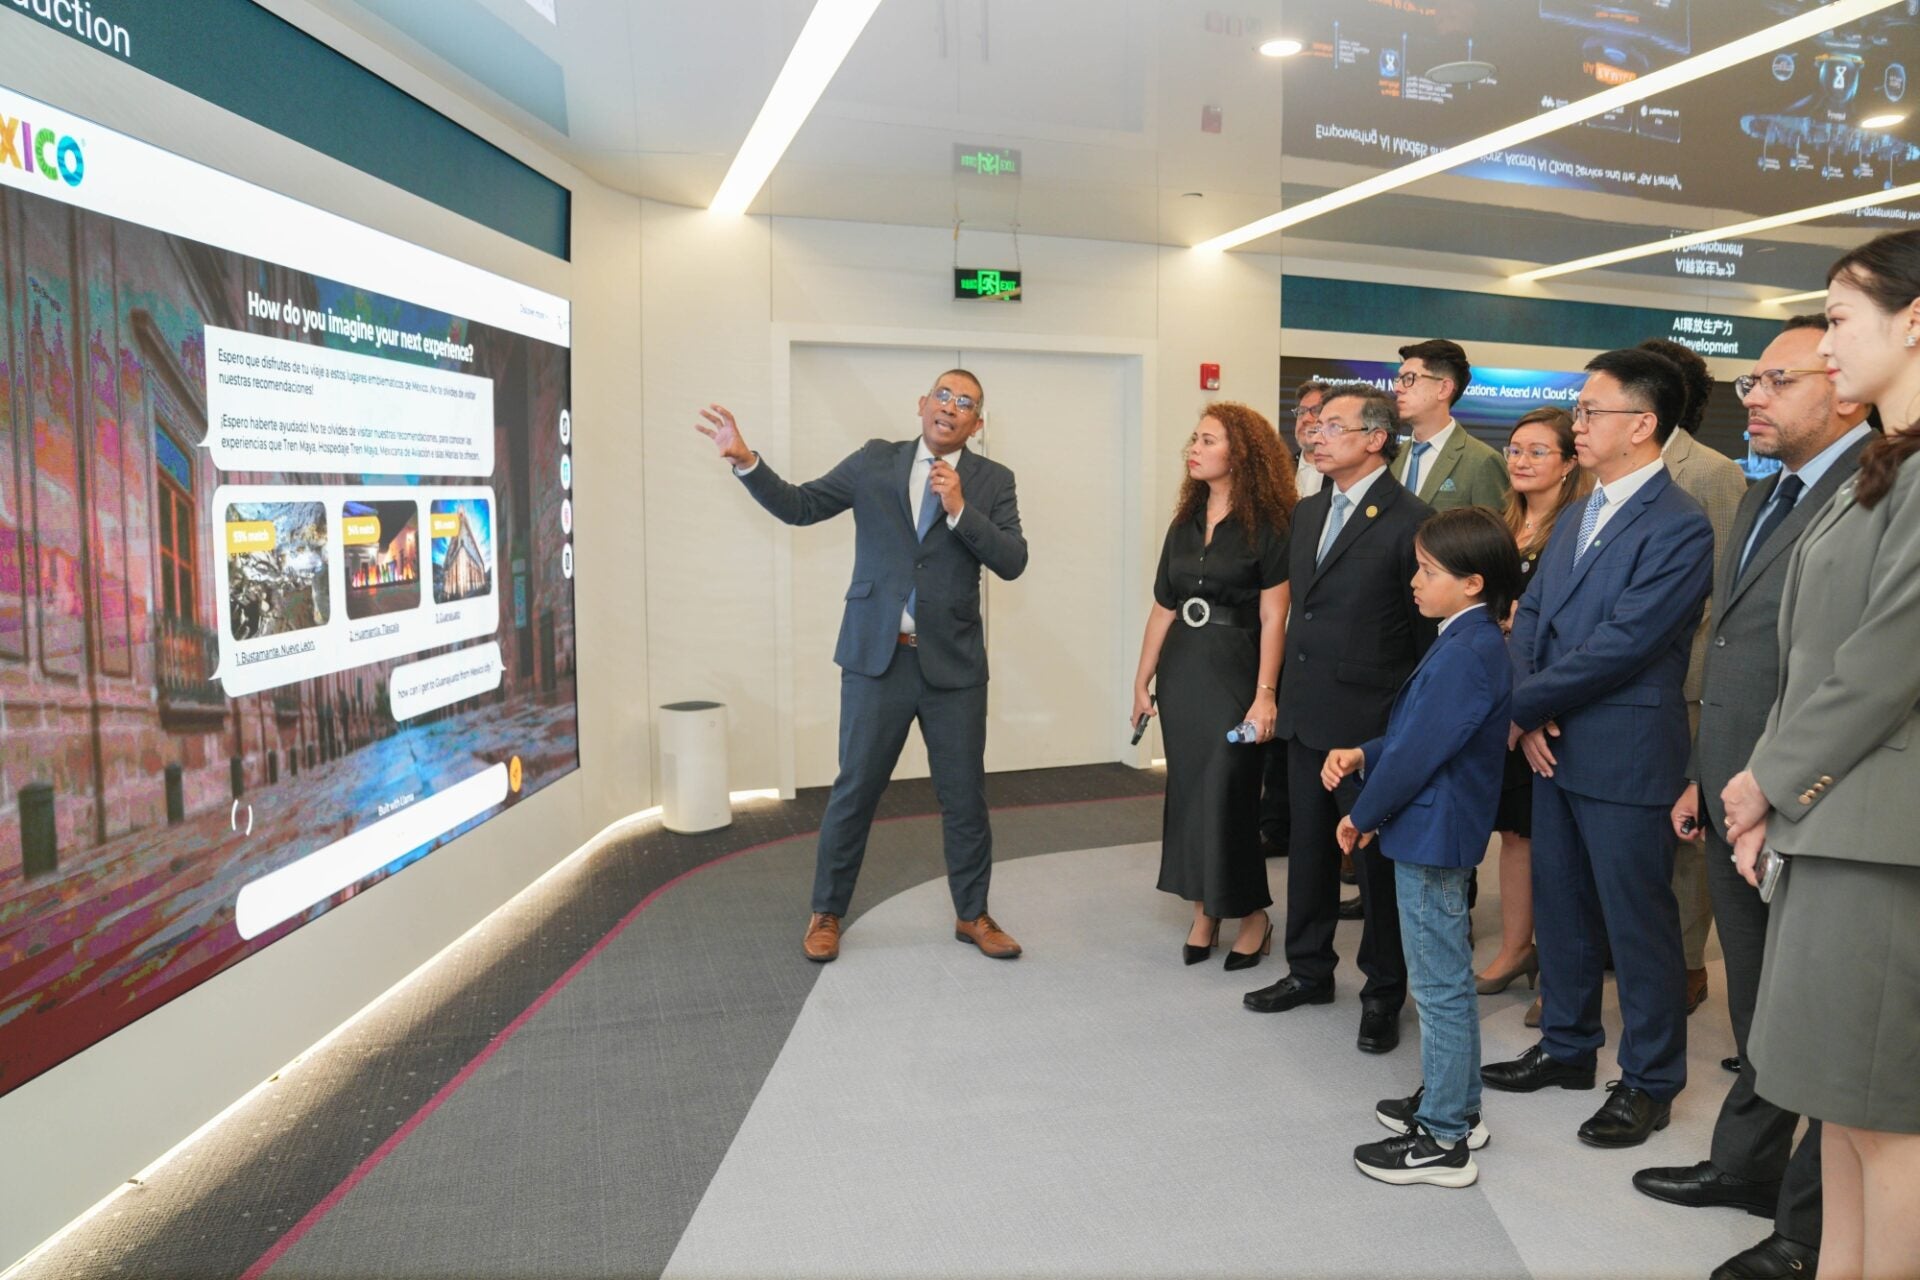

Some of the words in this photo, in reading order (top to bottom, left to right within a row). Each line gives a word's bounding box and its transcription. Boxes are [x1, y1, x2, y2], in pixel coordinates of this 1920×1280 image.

[13, 0, 130, 57] uction
[248, 290, 280, 320] How
[283, 298, 300, 326] do
[302, 308, 326, 333] you
[328, 308, 374, 343] imagine
[375, 325, 399, 348] your
[400, 332, 422, 352] next
[423, 337, 474, 362] experience?
[1673, 317, 1733, 336] AI释放生产力
[218, 348, 244, 366] Espero
[246, 355, 260, 368] que
[262, 356, 291, 372] disfrutes
[292, 362, 300, 373] de
[310, 364, 324, 380] viaje
[218, 373, 252, 386] nuestras
[252, 376, 314, 396] recomendaciones!
[1463, 384, 1498, 397] cations:
[1500, 385, 1529, 398] Ascend
[1532, 386, 1540, 398] AI
[1542, 386, 1566, 400] Cloud
[250, 416, 278, 432] haberte
[310, 422, 319, 434] No
[222, 436, 268, 452] experiencias
[269, 440, 282, 452] que
[283, 438, 298, 451] Tren
[398, 689, 408, 699] how
